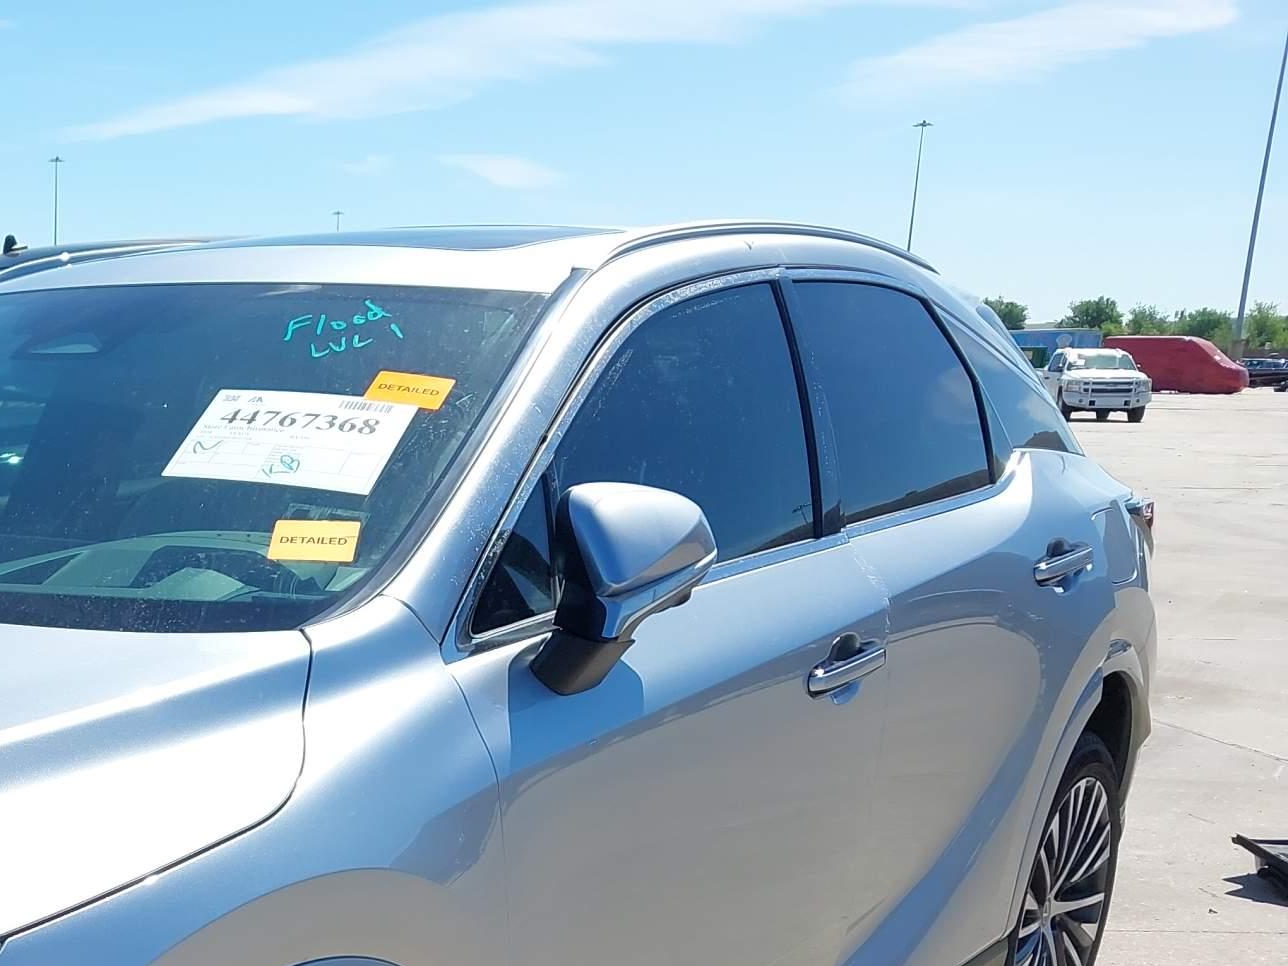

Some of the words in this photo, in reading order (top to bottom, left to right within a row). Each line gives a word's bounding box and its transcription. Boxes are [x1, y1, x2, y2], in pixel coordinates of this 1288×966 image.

[284, 300, 392, 340] Flood
[377, 382, 441, 397] DETAILED
[220, 408, 380, 435] 44767368
[278, 535, 349, 547] DETAILED
